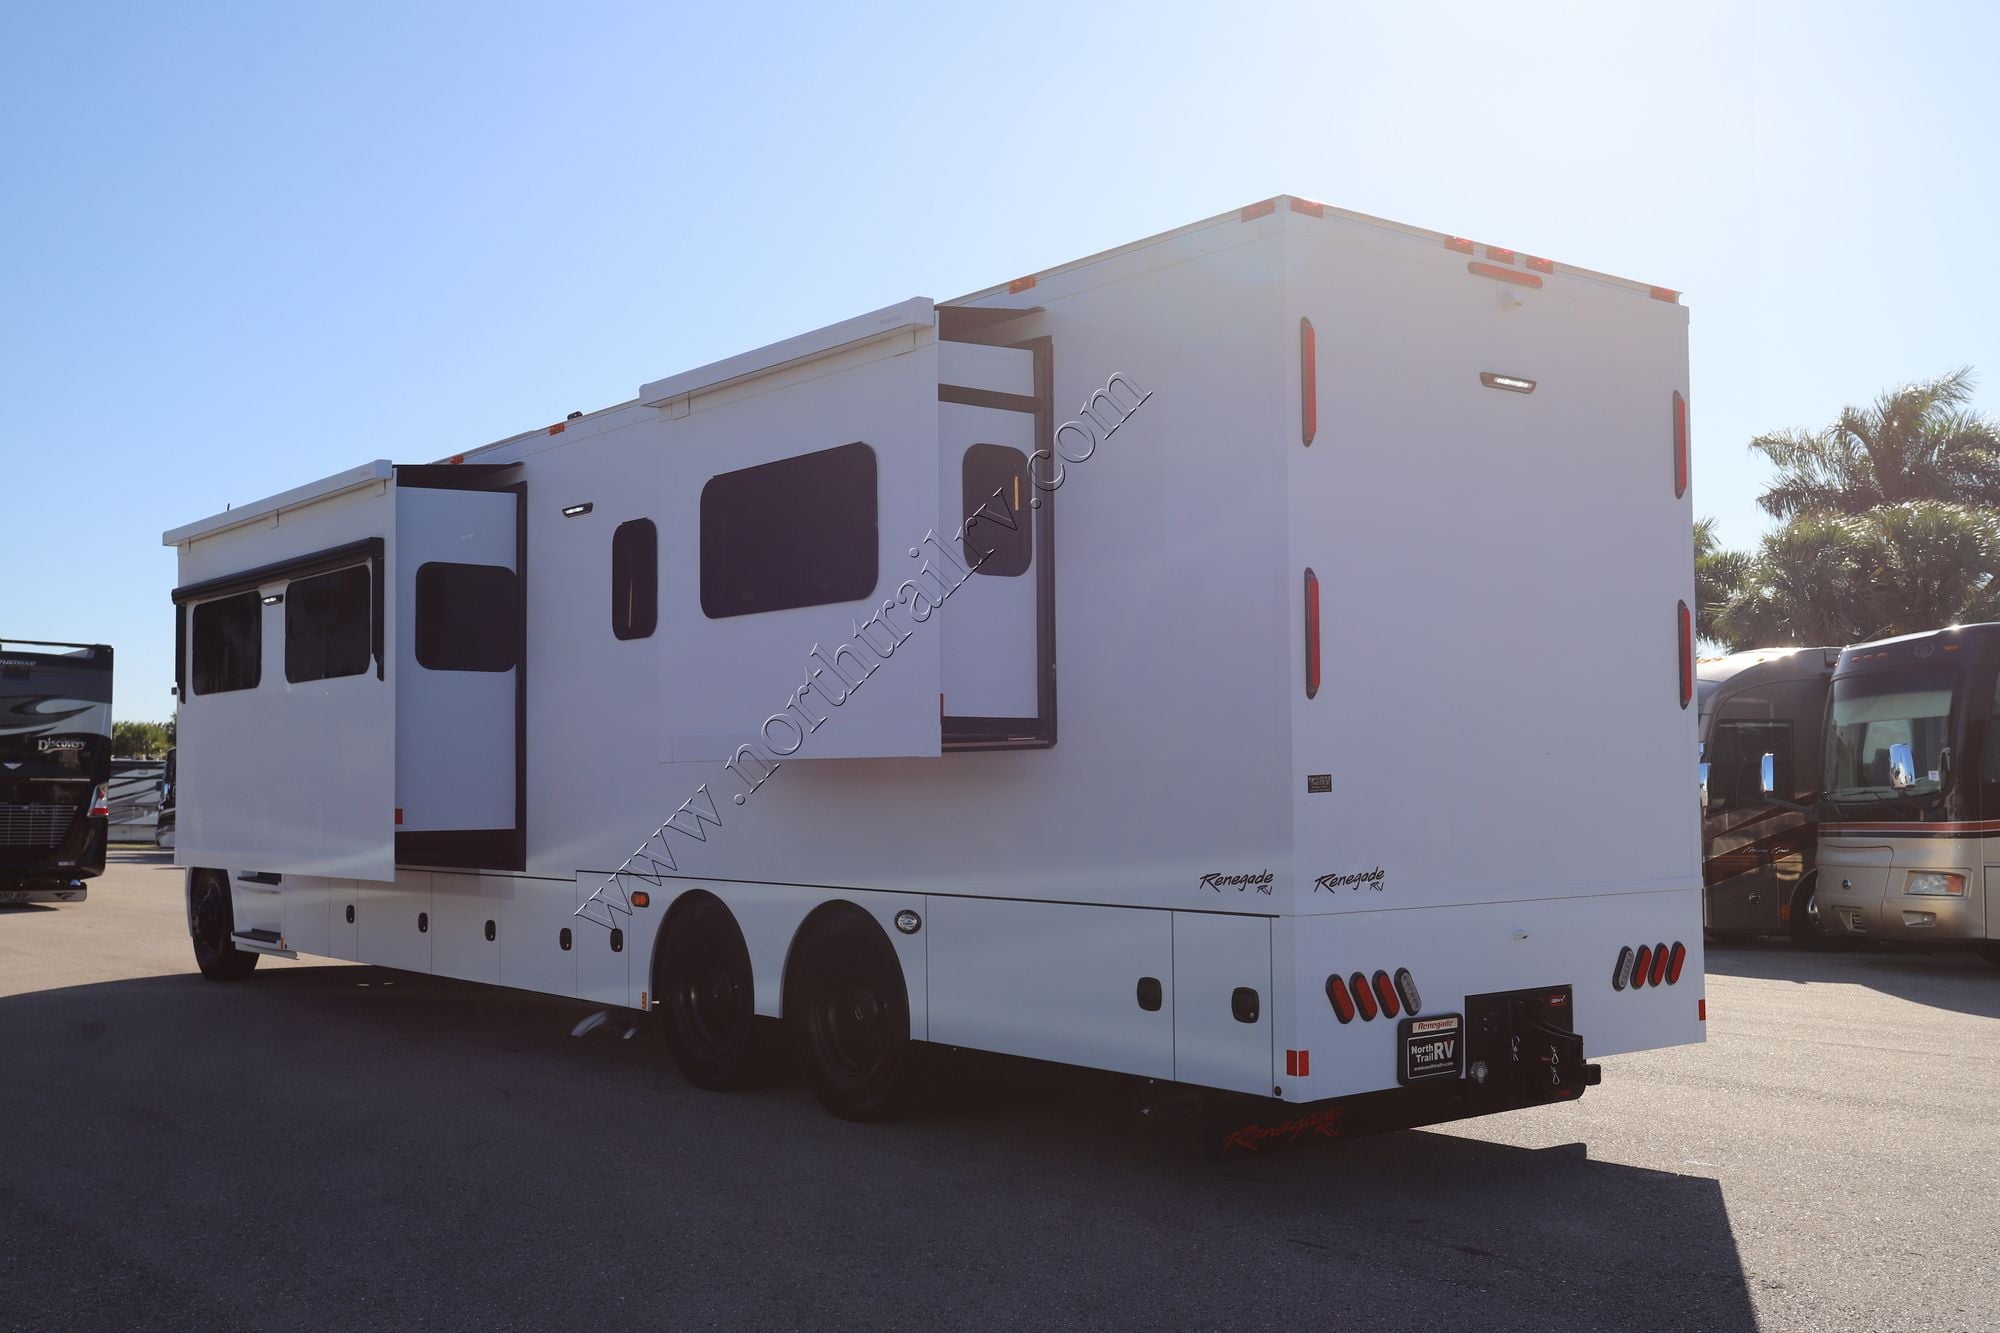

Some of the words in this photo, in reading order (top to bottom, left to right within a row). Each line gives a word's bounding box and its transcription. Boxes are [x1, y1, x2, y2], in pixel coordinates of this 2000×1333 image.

[38, 737, 87, 750] Discovery
[1199, 869, 1274, 893] Renegade
[1313, 866, 1385, 894] Renegade
[1256, 885, 1273, 896] RV
[1369, 881, 1384, 892] RV
[1417, 1020, 1455, 1030] Renegade
[1411, 1043, 1434, 1055] North
[1434, 1039, 1455, 1060] RV
[1416, 1052, 1434, 1063] Trail
[1222, 1104, 1345, 1154] Renegade
